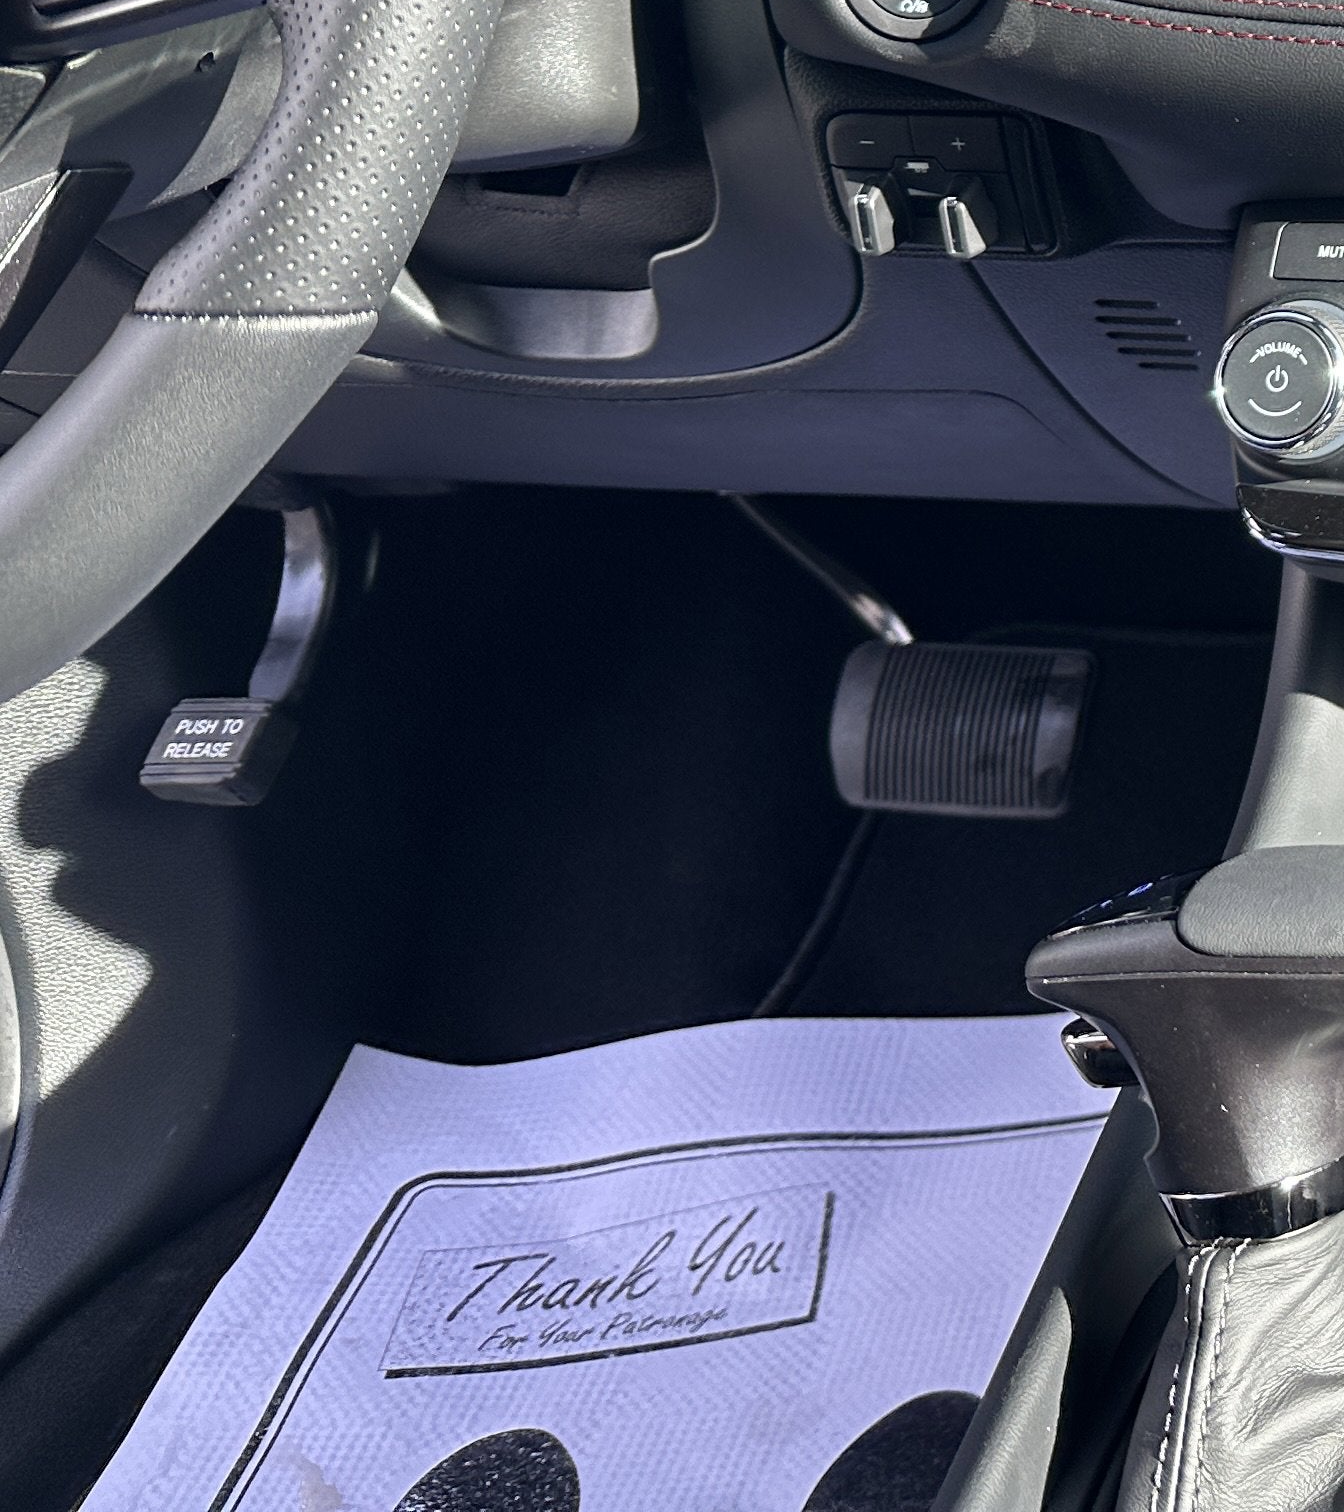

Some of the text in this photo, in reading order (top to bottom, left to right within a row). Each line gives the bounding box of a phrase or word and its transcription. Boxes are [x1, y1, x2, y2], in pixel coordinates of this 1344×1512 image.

[1256, 342, 1302, 358] VOLUME
[175, 719, 244, 735] PUSH TO
[162, 742, 234, 758] RELEASE
[446, 1206, 785, 1321] Thank You
[478, 1307, 729, 1351] For Your Patronage
